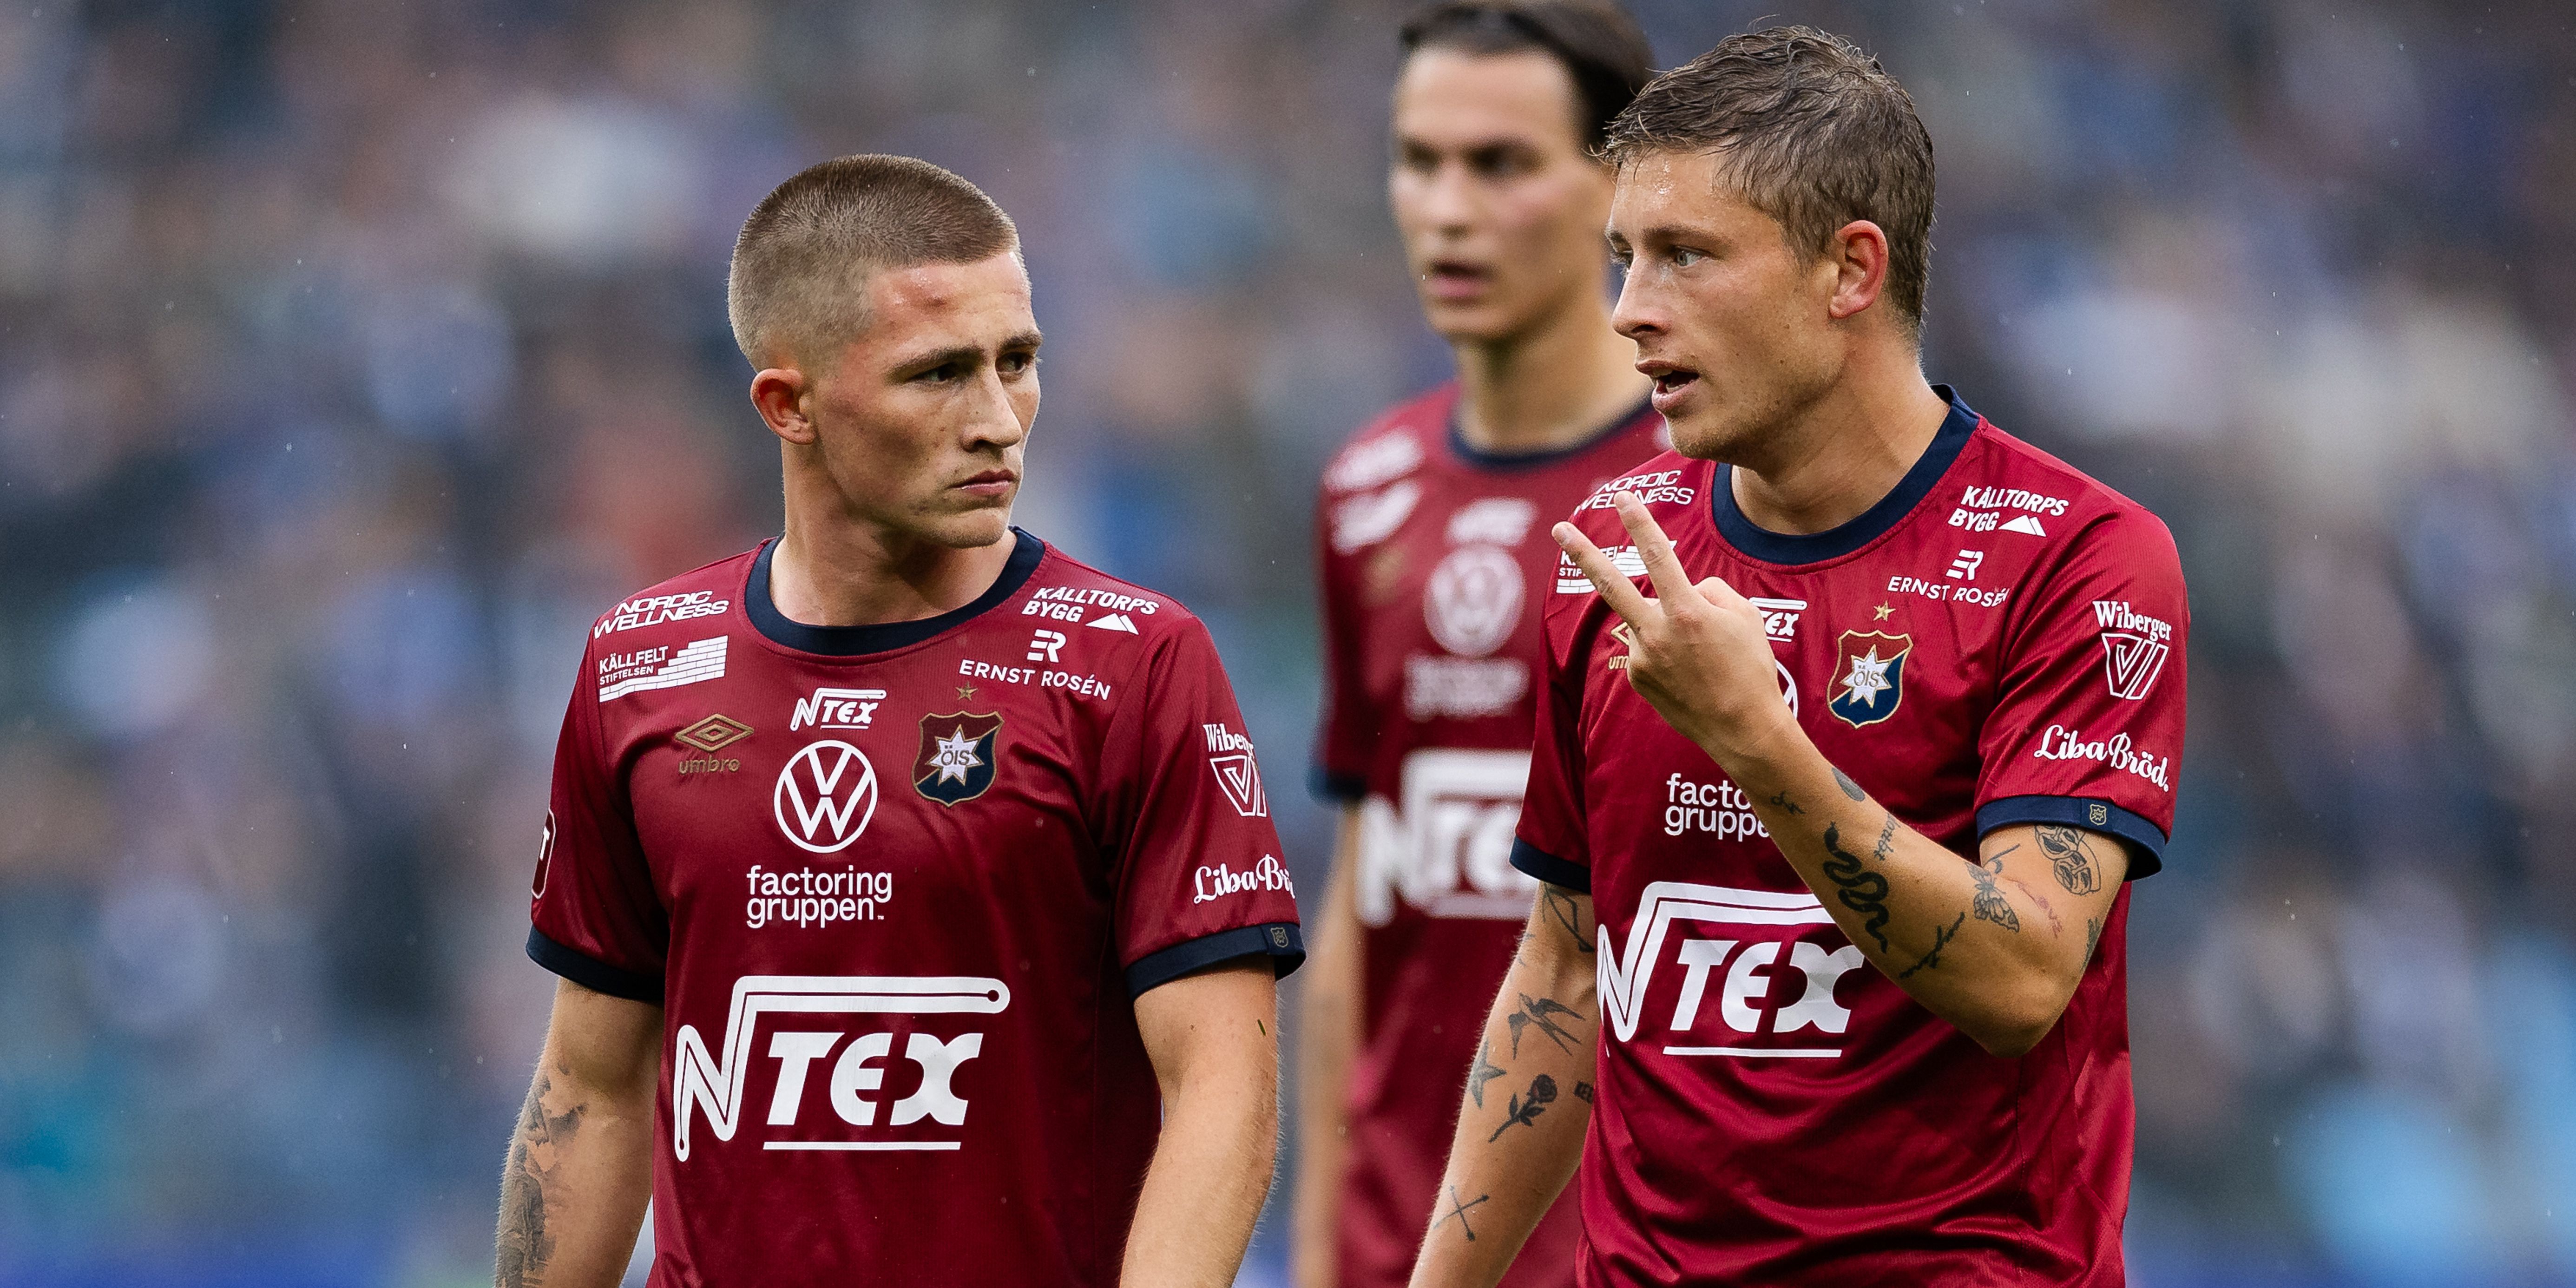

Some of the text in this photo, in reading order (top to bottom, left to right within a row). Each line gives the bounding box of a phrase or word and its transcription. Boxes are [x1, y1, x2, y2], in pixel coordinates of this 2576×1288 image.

[1595, 470, 1682, 494] NORDIC
[1573, 486, 1695, 516] WELNESS
[1960, 485, 2070, 516] KÅLLTORPS
[1947, 508, 2000, 532] BYGG
[615, 591, 713, 616] NORDIC
[1033, 586, 1160, 615] KÅLLTORPS
[1887, 576, 2010, 607] ERNST ROSÉ
[594, 600, 729, 639] WELLNESS
[1021, 600, 1084, 623] BYGG
[2092, 601, 2172, 642] Wiberger
[599, 645, 669, 674] KÄLLFELT
[599, 665, 654, 685] STIFTELSEN
[959, 659, 1111, 700] ERNST ROSÉN
[1854, 665, 1880, 687] ÖIS
[790, 688, 887, 731] NTEX
[679, 754, 741, 774] umbro
[941, 745, 970, 766] ÖIS
[1667, 773, 1751, 810] facto
[1664, 805, 1770, 842] gruppe
[746, 865, 892, 903] factoring
[1597, 881, 1865, 1057] NTEX
[673, 975, 1010, 1162] NTEX
